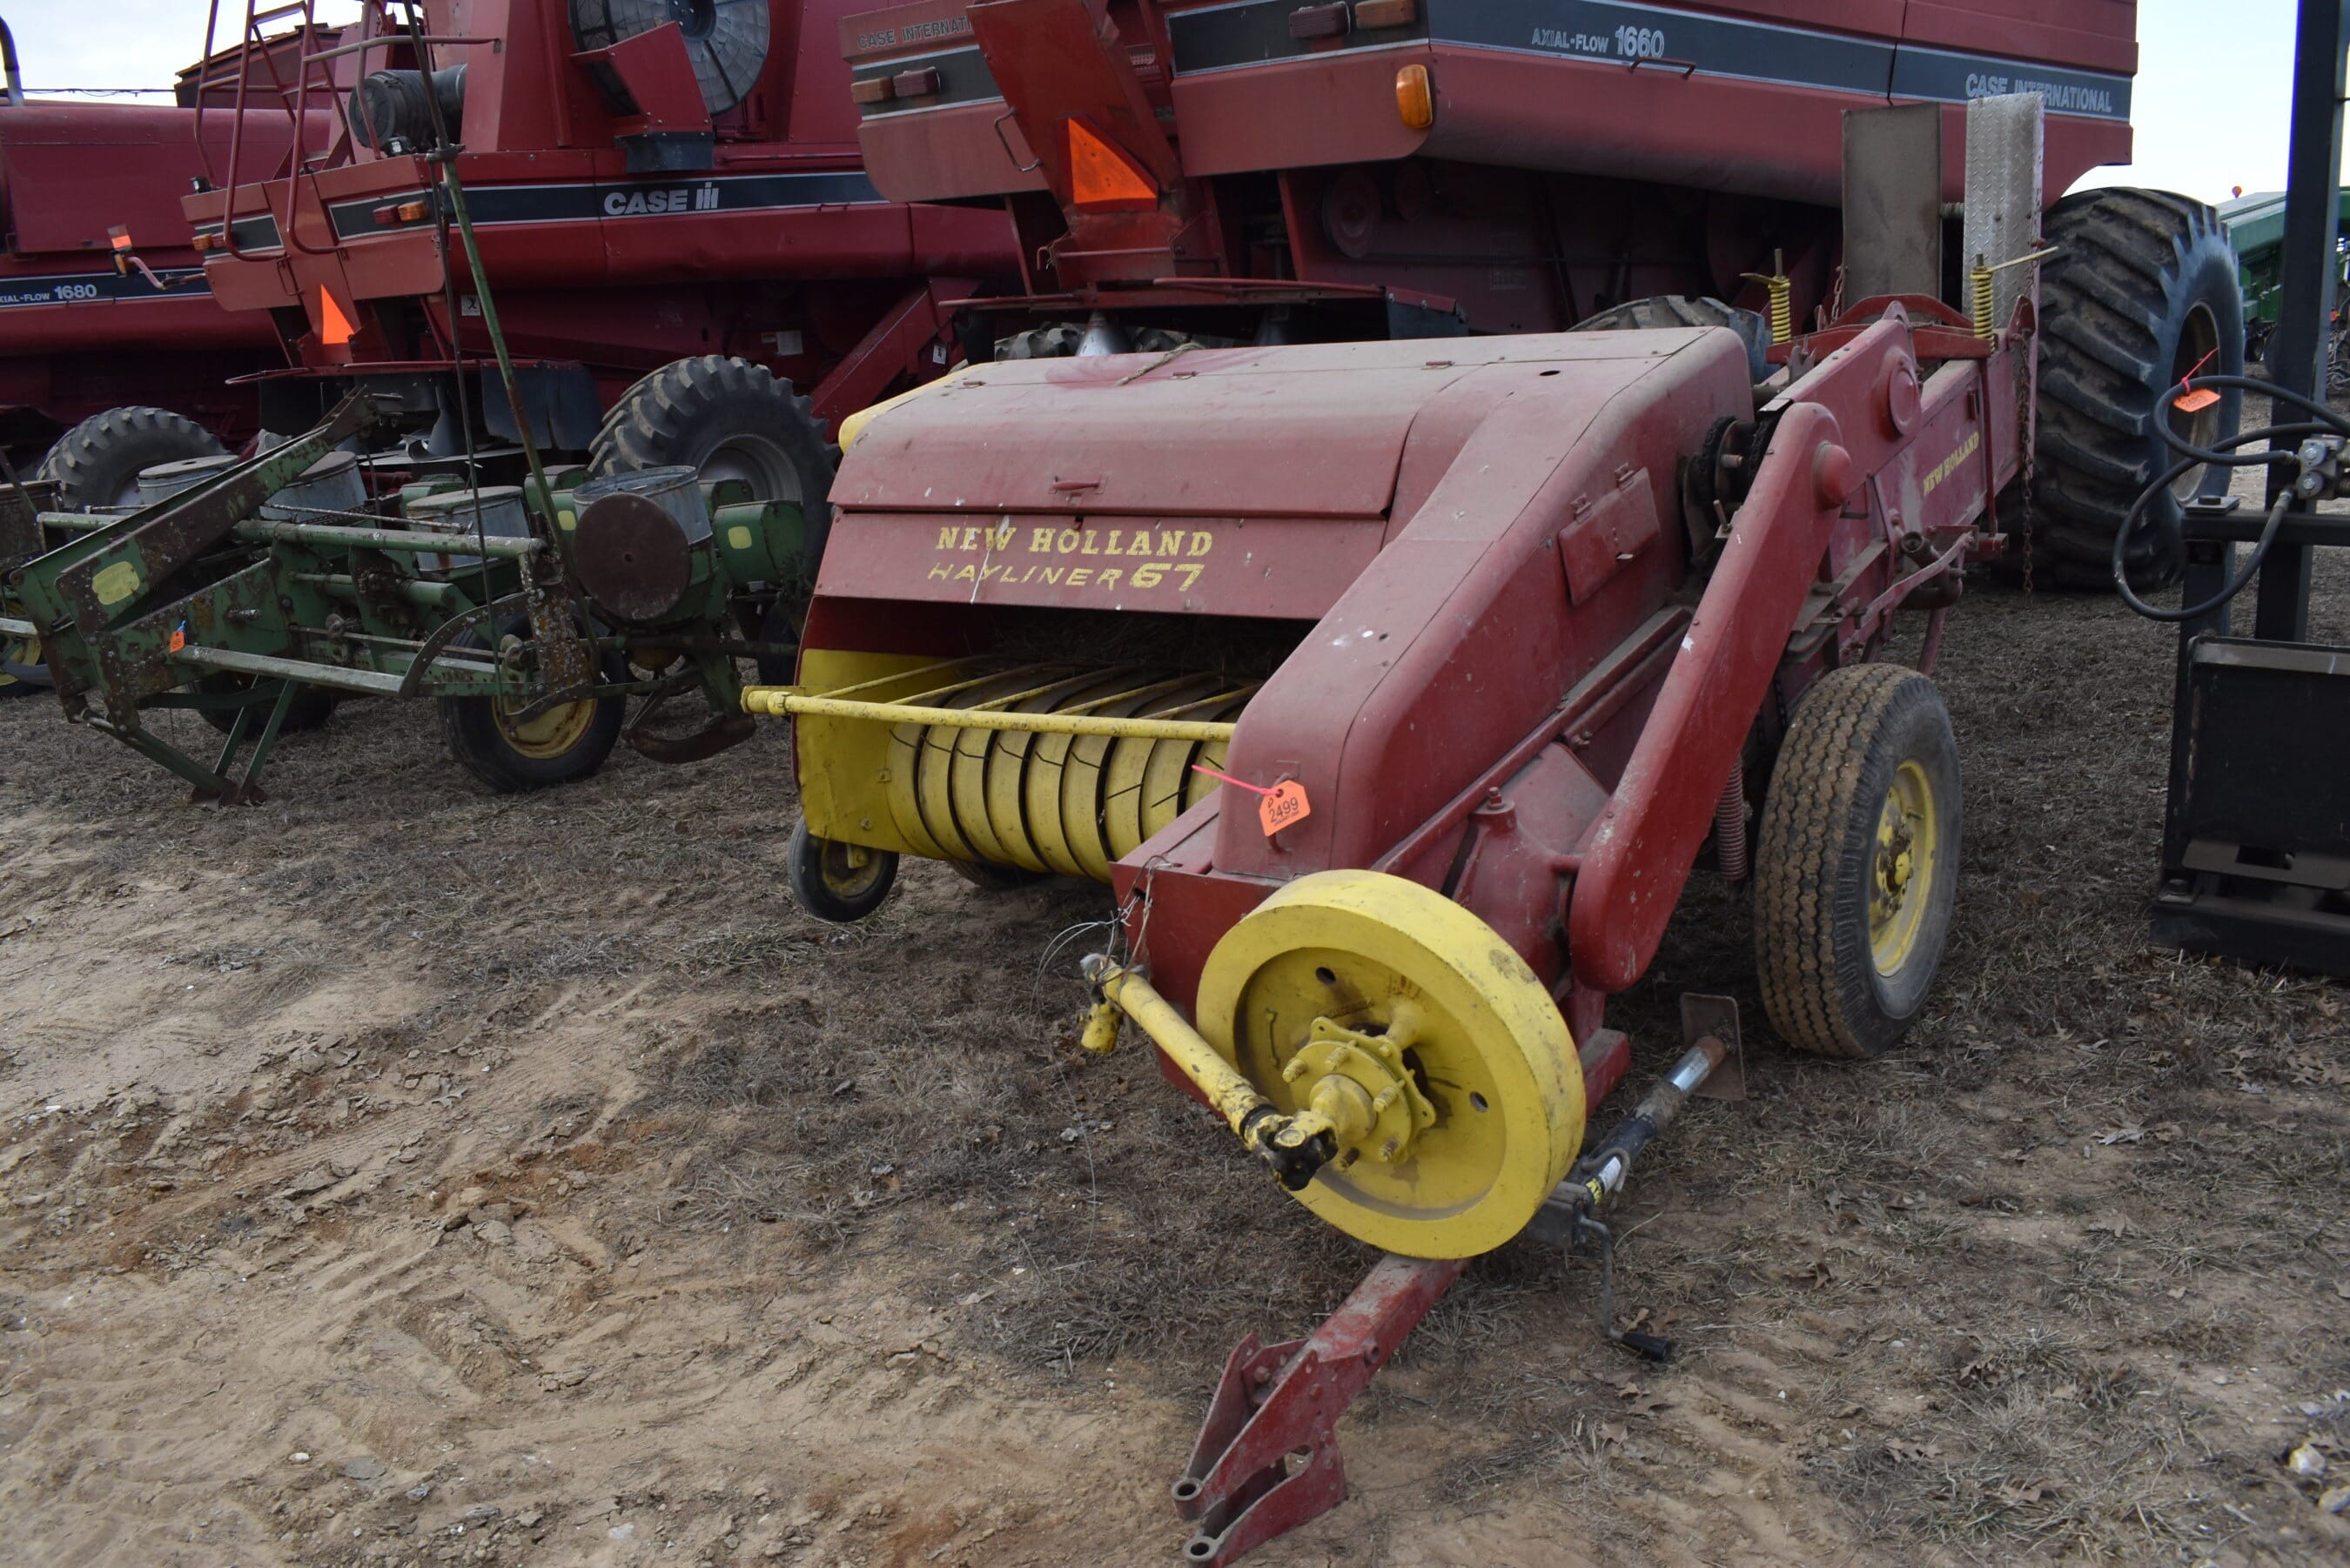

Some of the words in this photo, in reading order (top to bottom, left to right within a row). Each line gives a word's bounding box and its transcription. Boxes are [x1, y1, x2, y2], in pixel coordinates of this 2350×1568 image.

[856, 29, 896, 50] CASE
[1532, 28, 1609, 53] AXIAL-FLOW
[1615, 24, 1665, 59] 1660
[1965, 73, 2008, 97] CASE
[604, 189, 688, 216] CASE
[54, 284, 97, 299] 1680
[936, 526, 1017, 551] NEW
[1029, 527, 1213, 557] HOLLAND
[928, 562, 1124, 591] HAYLINER
[1129, 562, 1205, 593] 67
[1268, 796, 1299, 823] 2499
